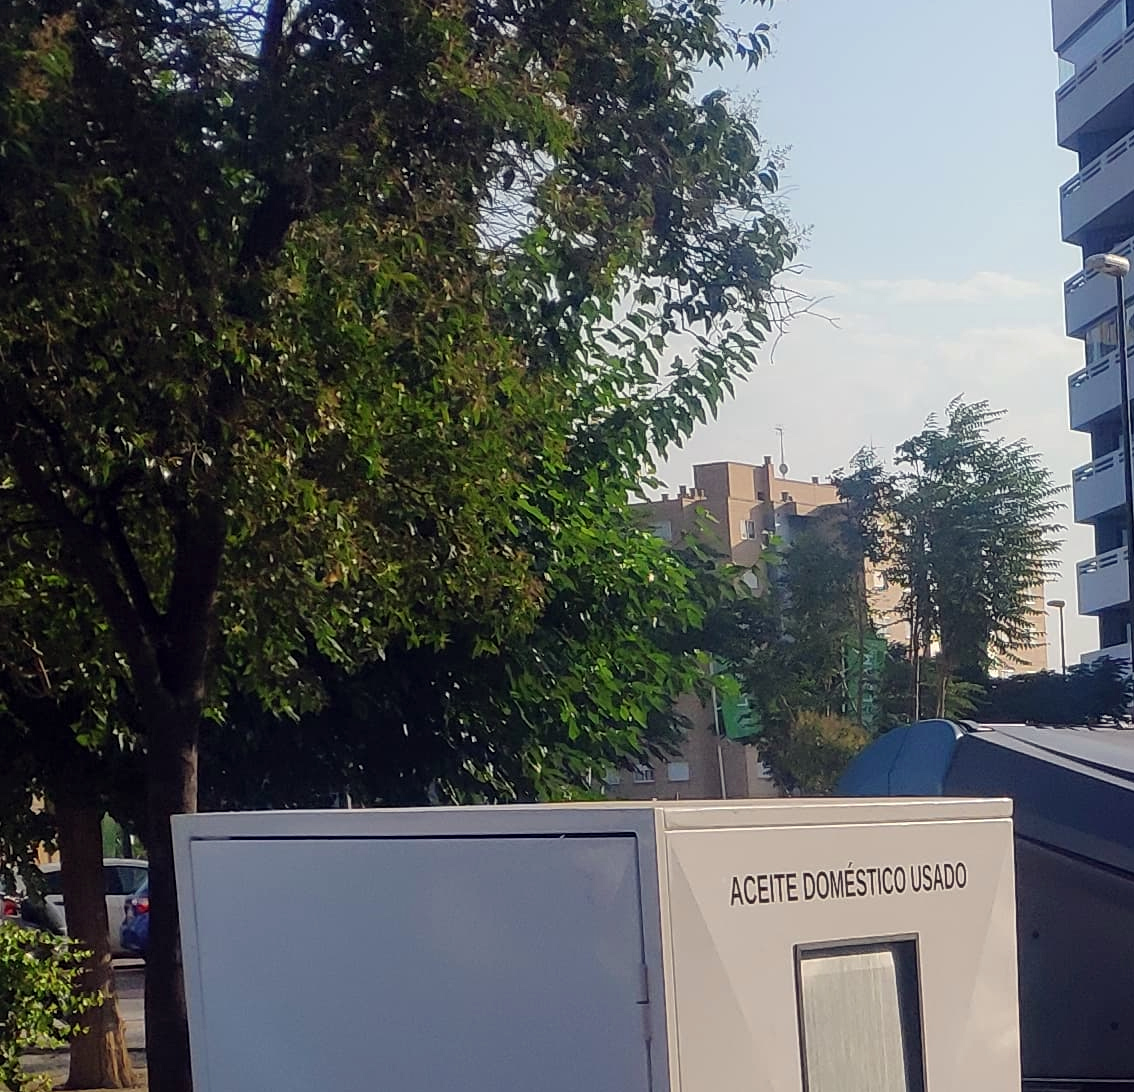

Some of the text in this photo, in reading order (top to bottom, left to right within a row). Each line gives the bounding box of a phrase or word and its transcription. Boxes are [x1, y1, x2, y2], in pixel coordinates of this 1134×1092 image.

[730, 861, 967, 906] ACEITE DOMÉSTICO USADO
